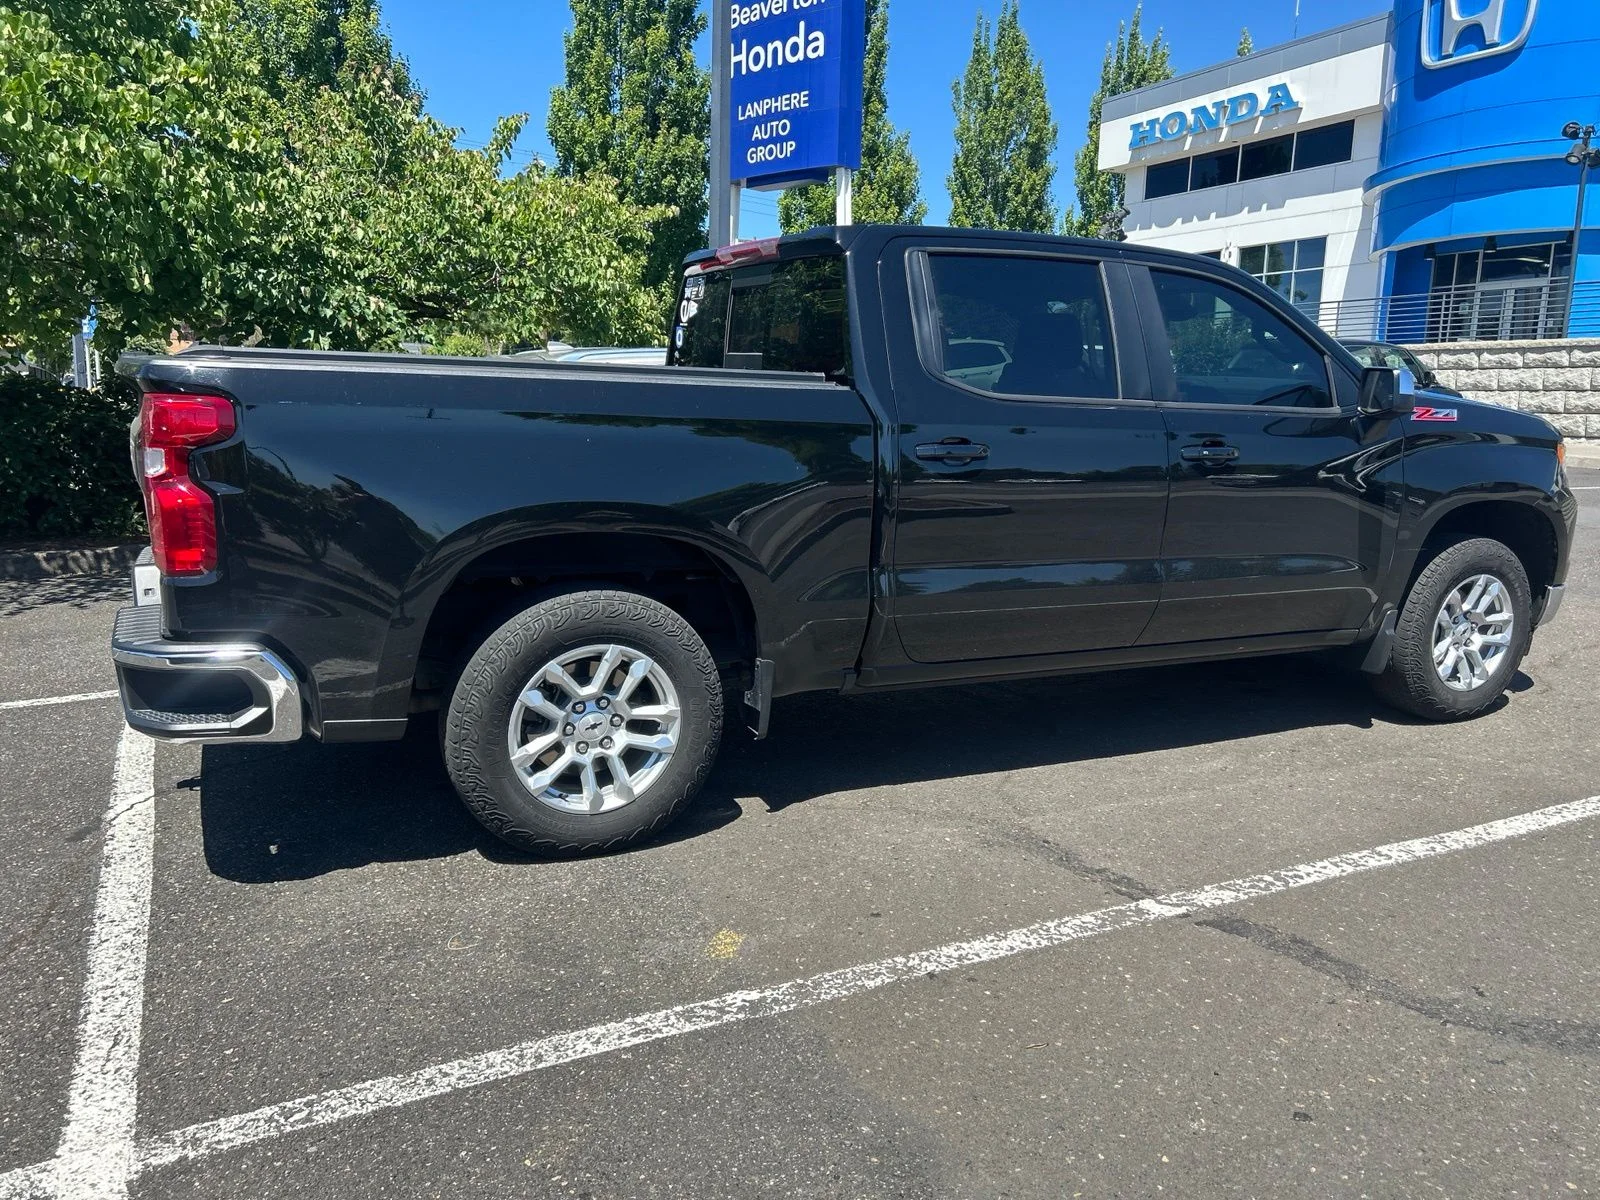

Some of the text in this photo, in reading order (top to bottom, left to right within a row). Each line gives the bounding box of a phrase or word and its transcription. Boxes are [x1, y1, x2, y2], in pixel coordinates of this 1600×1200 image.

[731, 20, 825, 78] Honda
[738, 91, 809, 121] LANPHERE
[1129, 83, 1299, 150] HONDA
[752, 119, 790, 141] AUTO
[747, 141, 796, 163] GROUP
